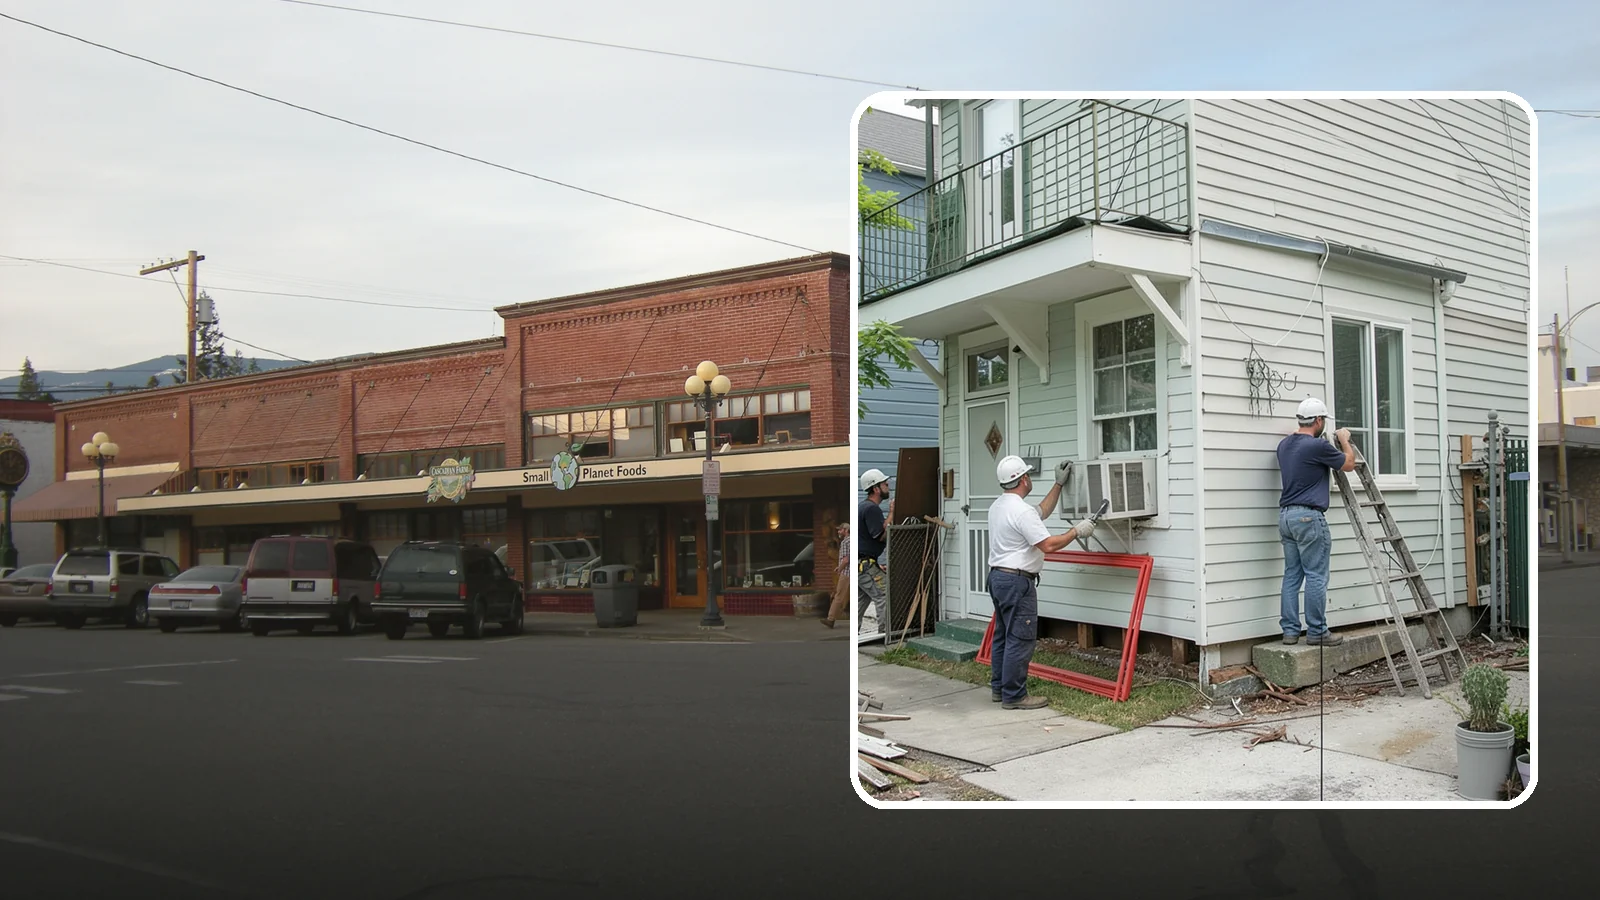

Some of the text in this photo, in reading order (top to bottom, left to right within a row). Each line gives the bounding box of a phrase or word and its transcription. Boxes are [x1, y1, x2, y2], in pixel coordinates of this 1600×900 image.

[523, 464, 647, 483] Small Planet Foods
